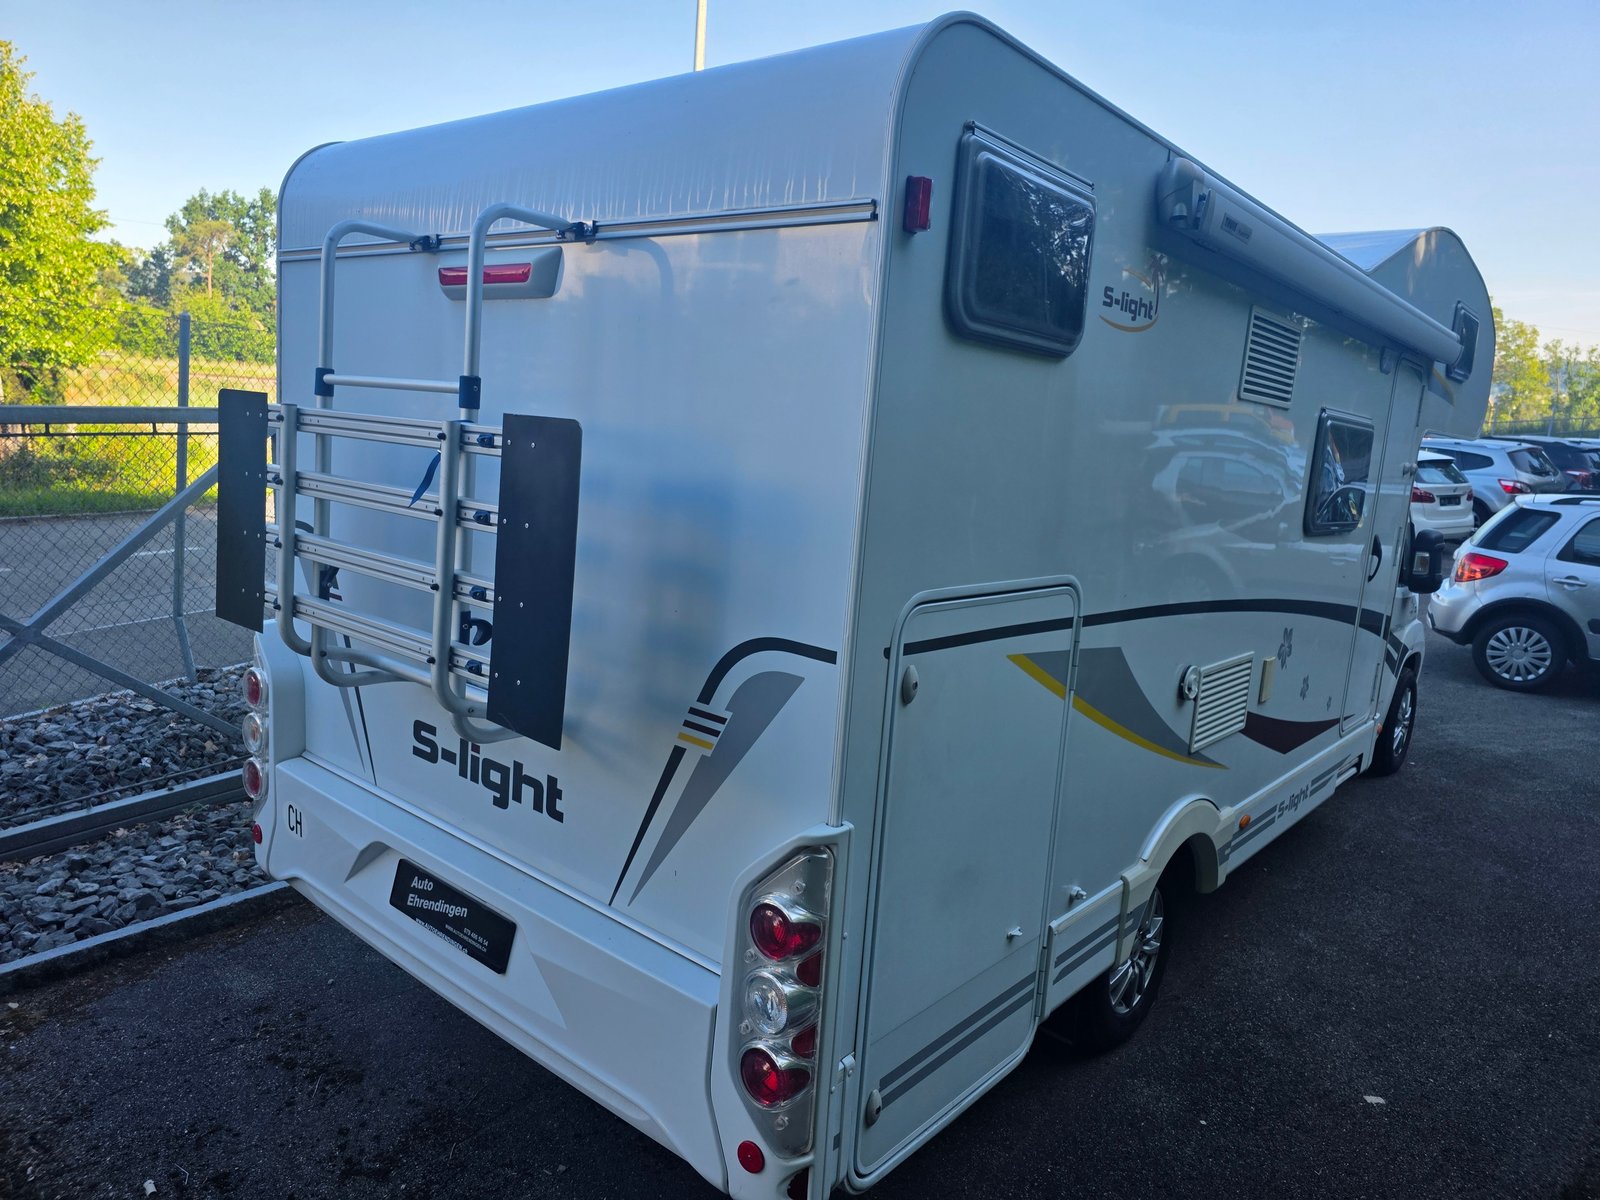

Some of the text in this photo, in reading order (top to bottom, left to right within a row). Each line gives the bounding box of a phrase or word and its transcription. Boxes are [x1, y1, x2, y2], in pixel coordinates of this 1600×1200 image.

[1102, 286, 1153, 321] S-light
[412, 719, 564, 824] S-light
[288, 804, 303, 838] CH
[411, 876, 433, 891] Auto
[407, 894, 468, 917] Ehrendingen
